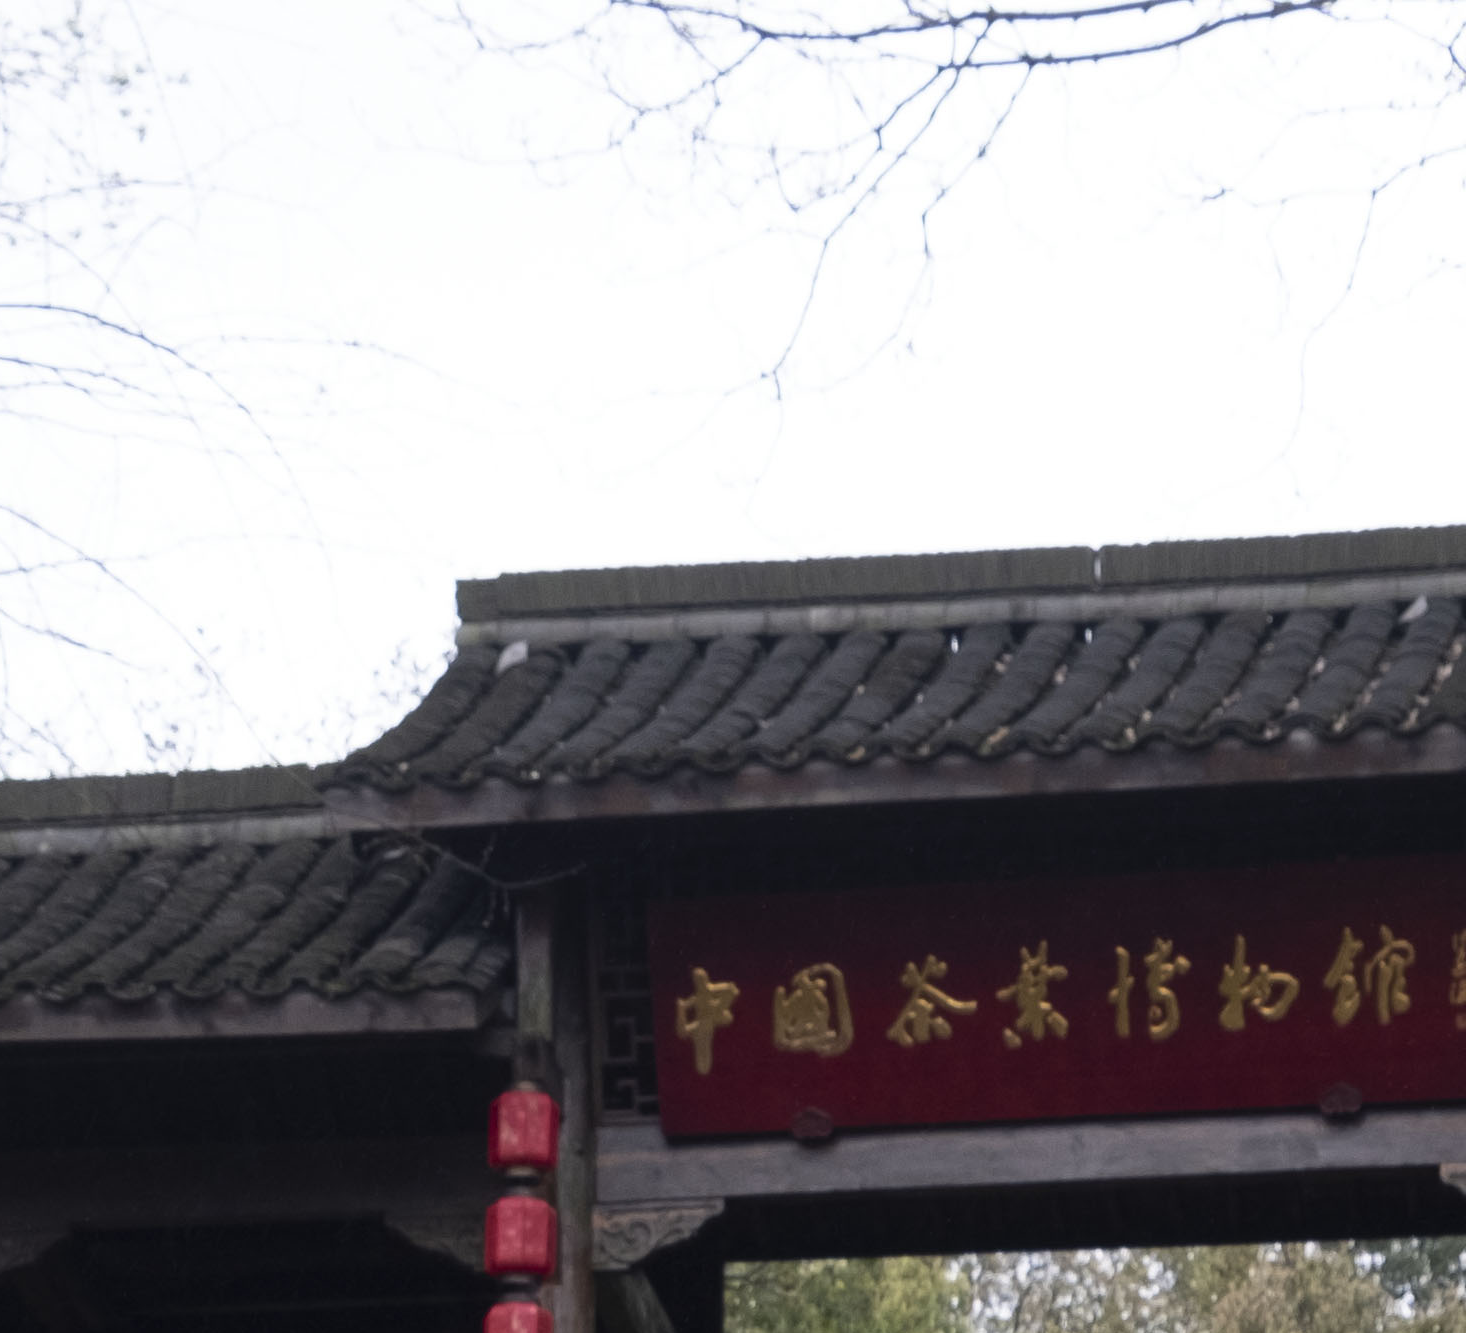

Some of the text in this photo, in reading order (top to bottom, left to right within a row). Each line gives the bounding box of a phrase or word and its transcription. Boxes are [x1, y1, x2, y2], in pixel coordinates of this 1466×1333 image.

[675, 924, 1416, 1075] 中國茶葉博物館
